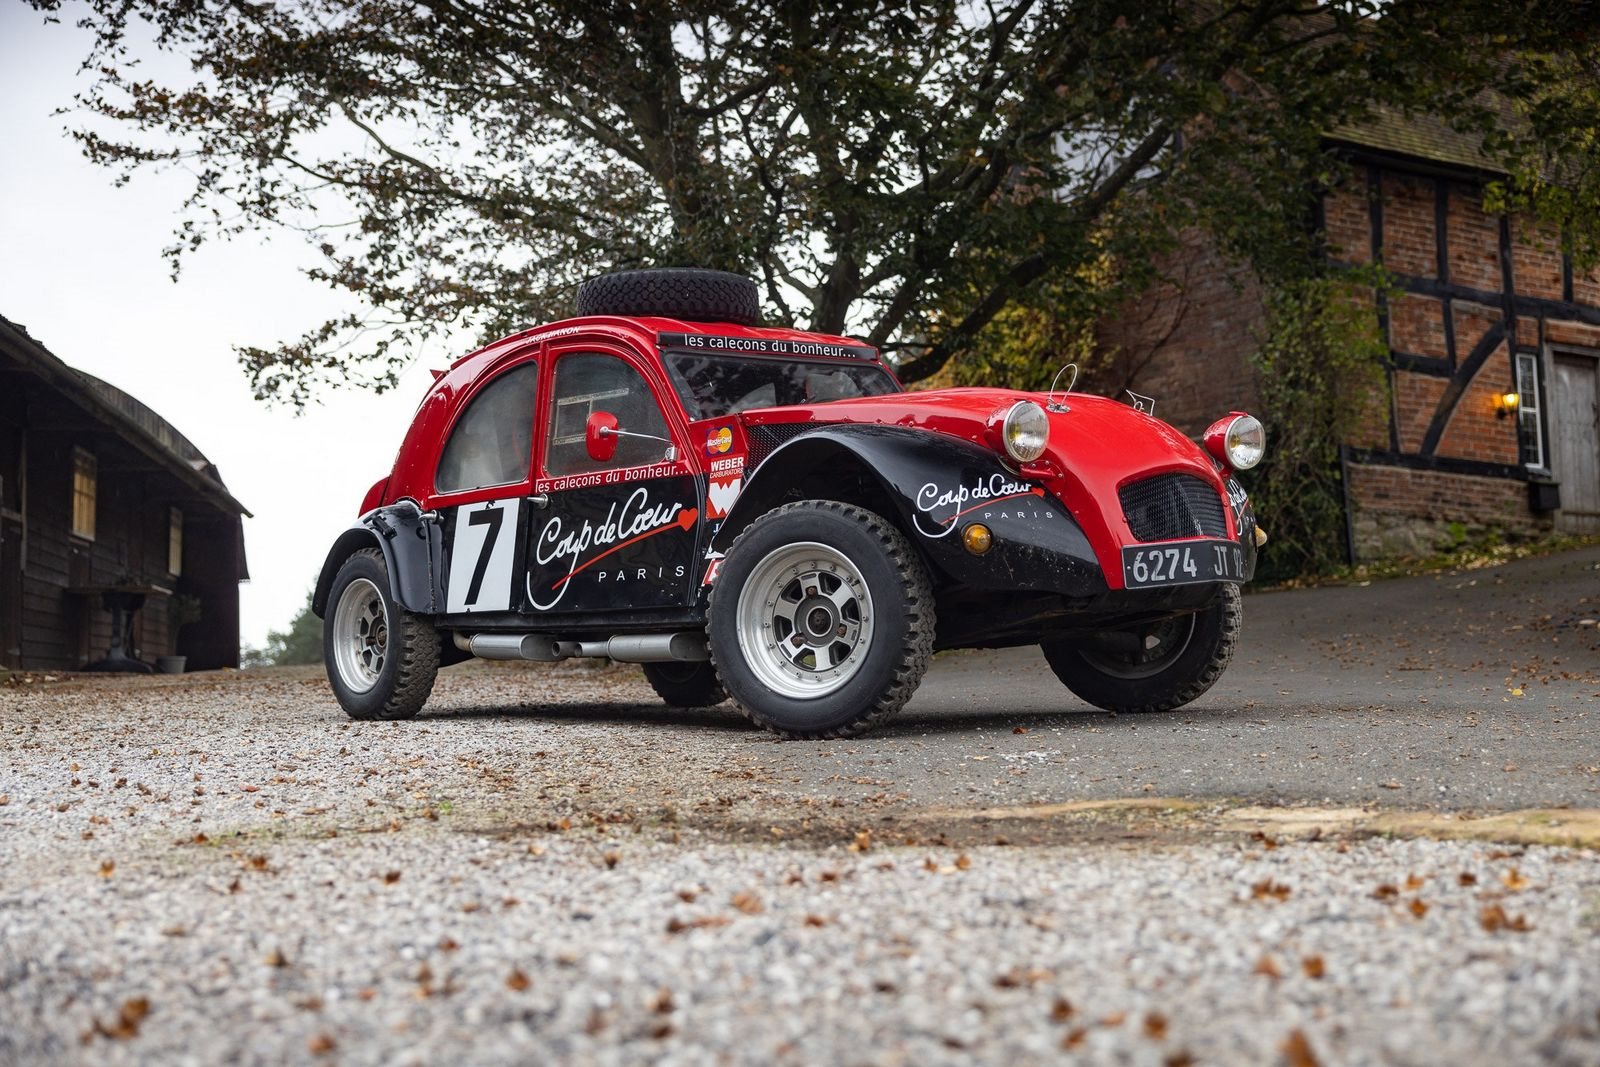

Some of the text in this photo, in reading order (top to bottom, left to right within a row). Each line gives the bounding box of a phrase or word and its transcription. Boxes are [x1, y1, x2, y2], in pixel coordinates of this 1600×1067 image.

[684, 333, 856, 358] les caleçons du bonheur...
[535, 464, 688, 493] les caleçons du bonheur...
[710, 456, 745, 472] WEBER
[912, 482, 969, 539] Coup
[972, 477, 991, 499] de
[985, 510, 1053, 520] PARIS
[464, 507, 504, 606] 7
[526, 516, 592, 611] Coup
[593, 501, 616, 545] de
[1132, 547, 1198, 583] 6274
[1213, 545, 1229, 577] JT
[598, 564, 685, 583] PARIS
